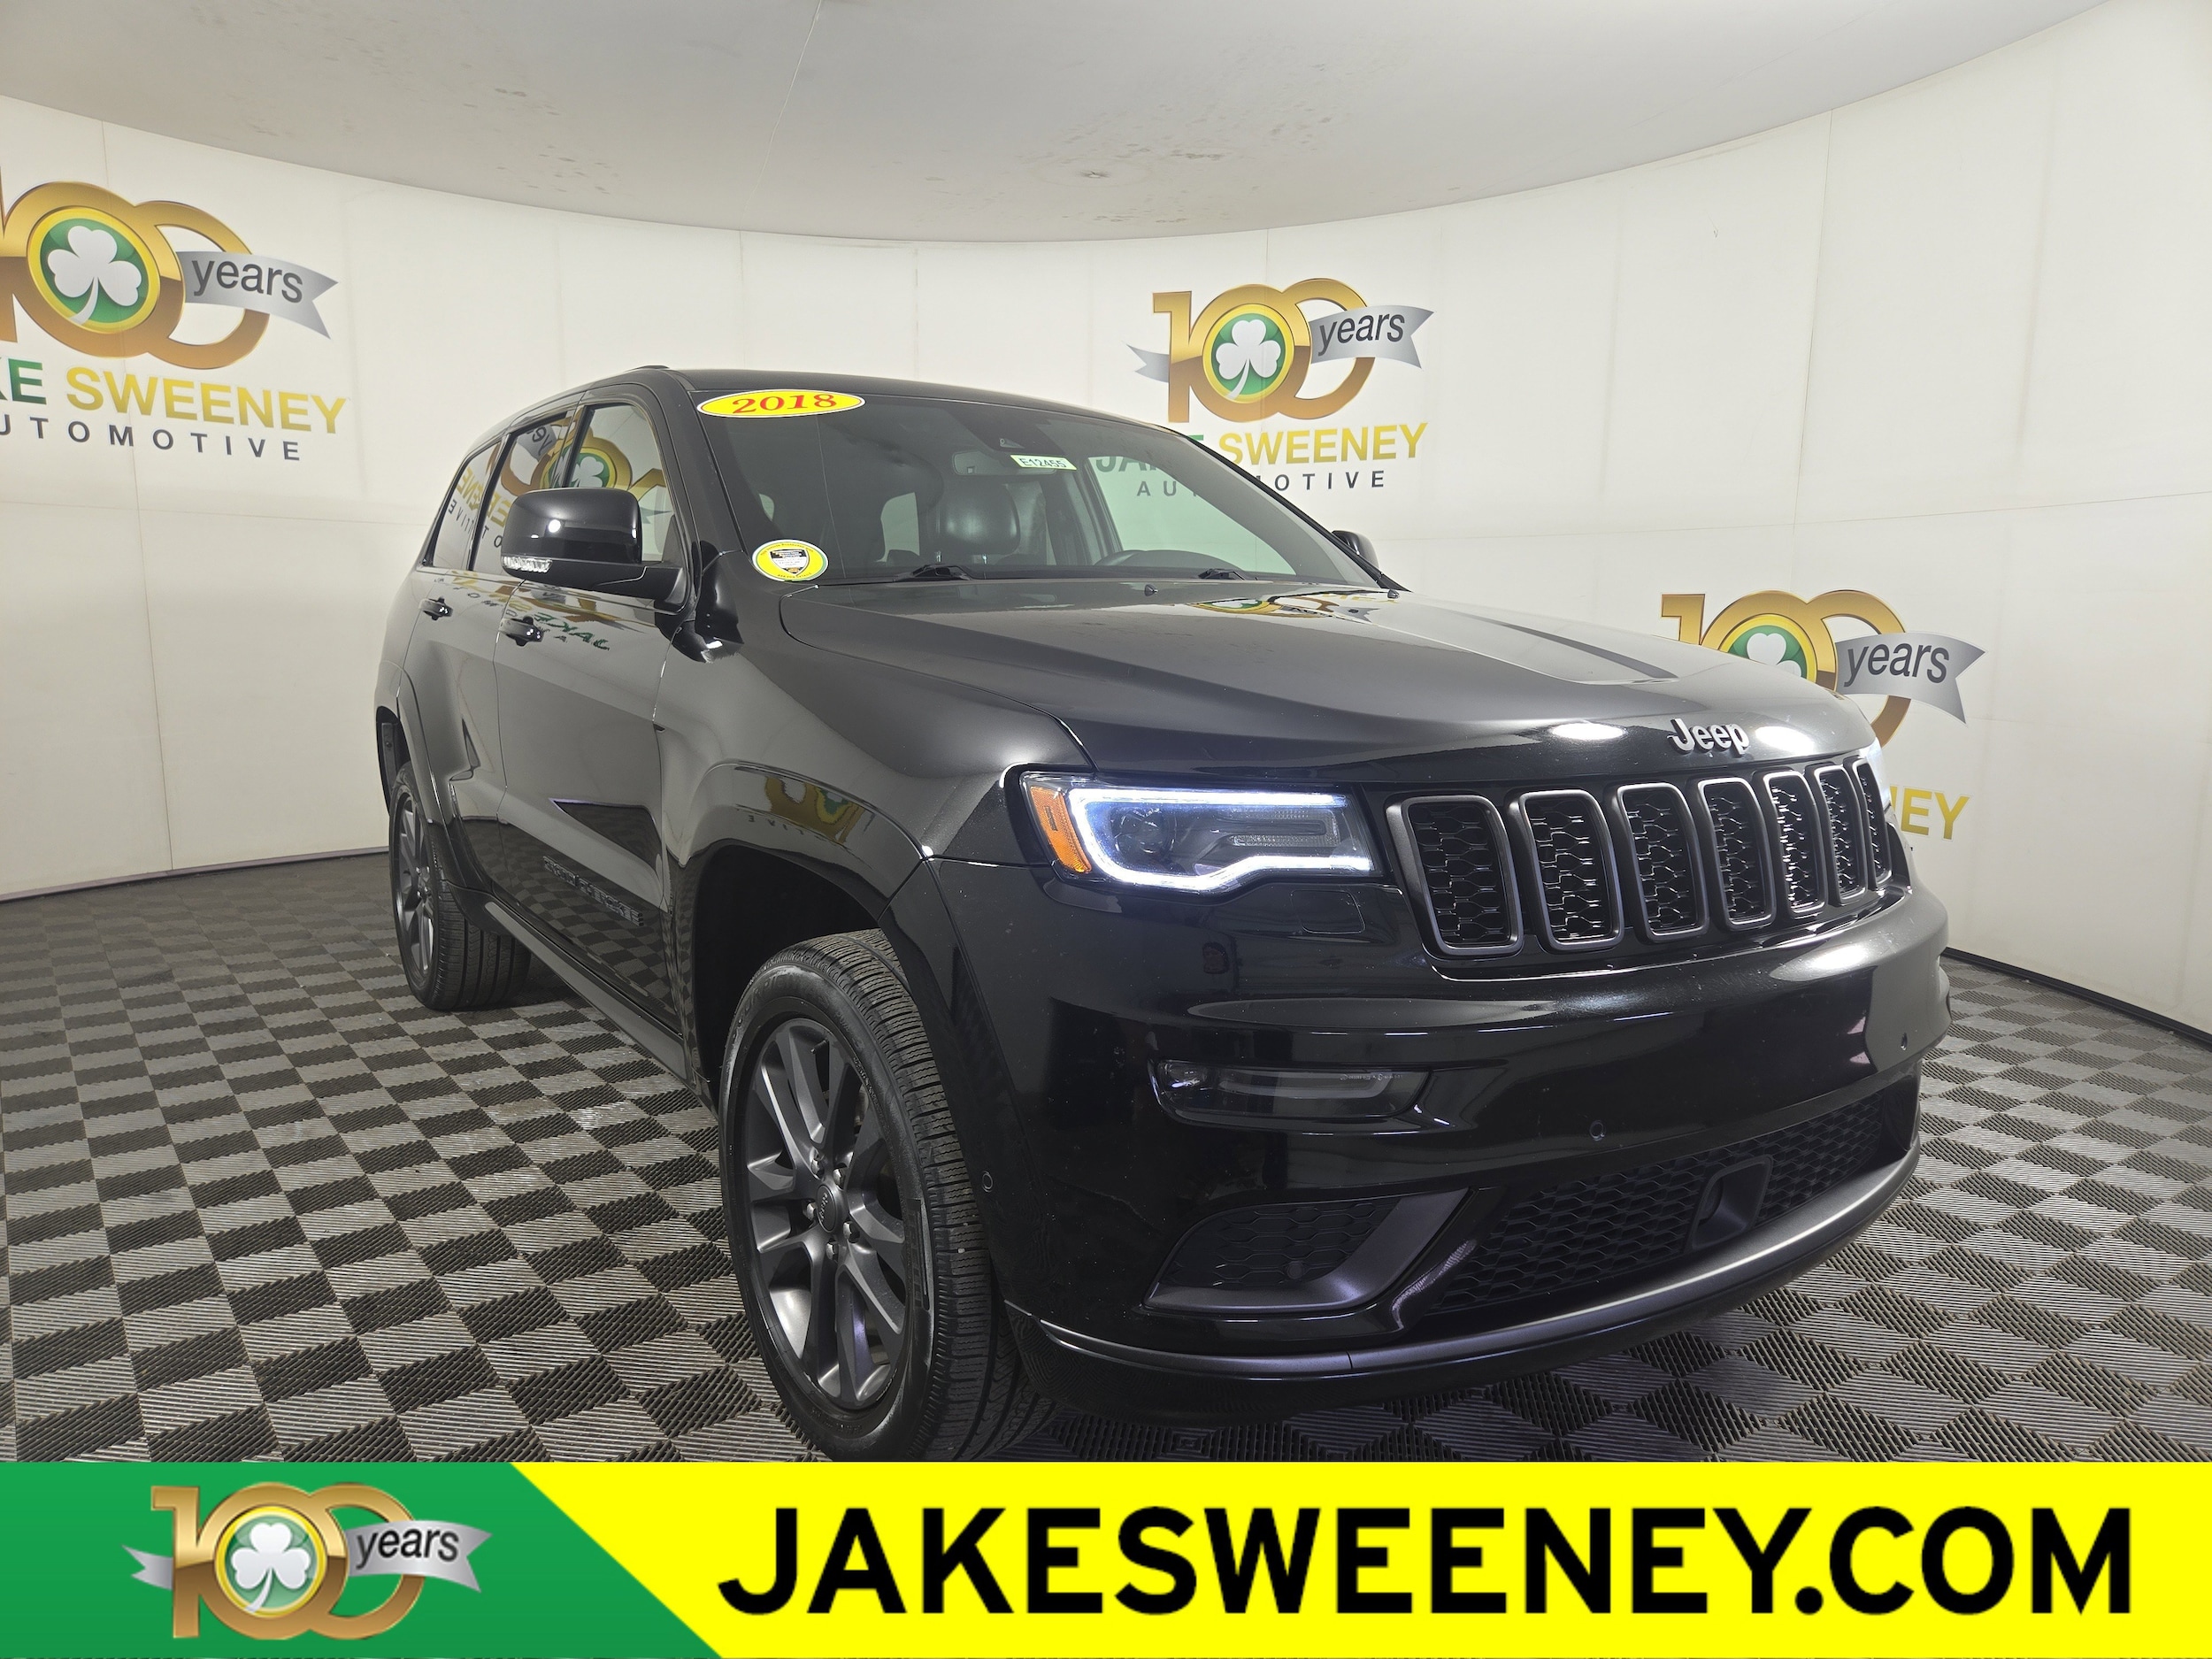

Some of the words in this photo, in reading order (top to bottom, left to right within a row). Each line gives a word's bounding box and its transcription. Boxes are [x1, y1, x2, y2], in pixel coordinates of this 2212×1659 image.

[191, 259, 303, 303] years
[1152, 277, 1376, 423] 100
[1318, 312, 1406, 356] years
[66, 366, 347, 434] SWEENEY
[732, 395, 837, 414] 2018
[1018, 457, 1068, 468] E12455
[1218, 422, 1429, 466] SWEENEY
[1843, 642, 1950, 688] years
[1667, 718, 1750, 757] Jeep
